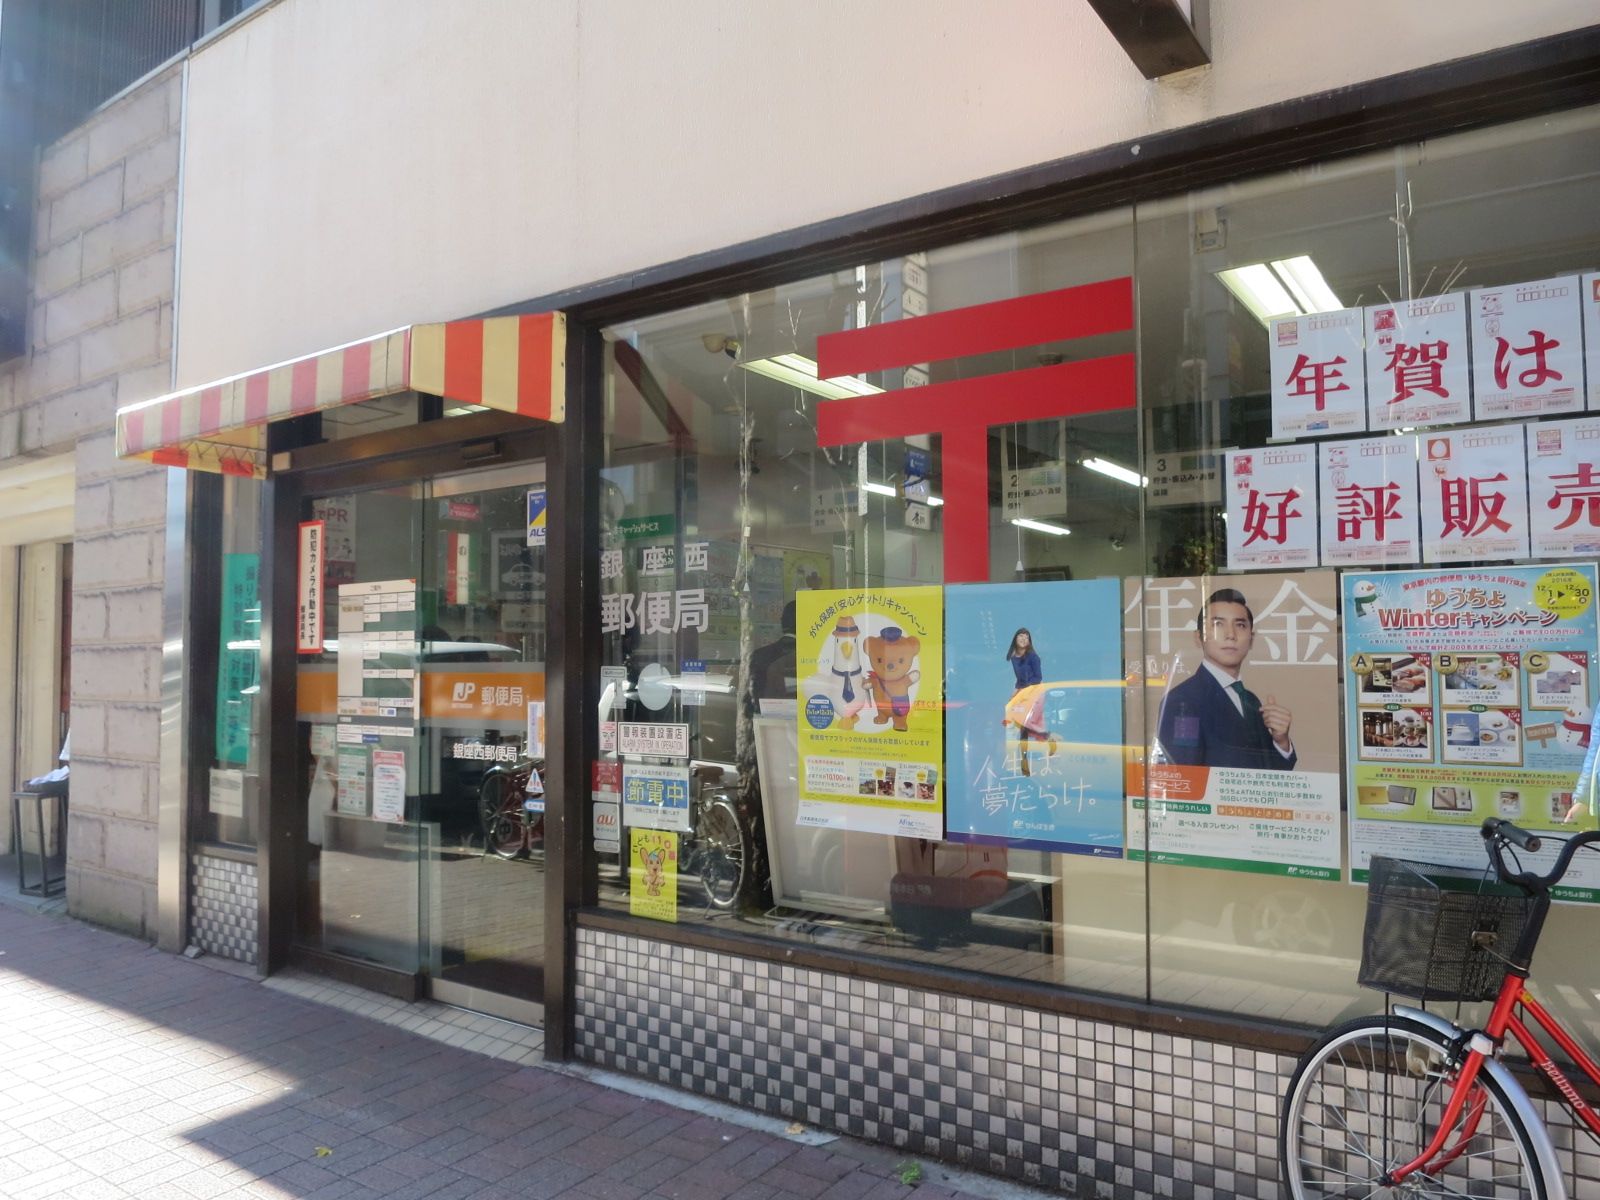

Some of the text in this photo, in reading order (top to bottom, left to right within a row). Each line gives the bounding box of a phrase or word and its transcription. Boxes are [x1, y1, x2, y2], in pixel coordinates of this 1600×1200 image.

[1285, 330, 1563, 412] 年賀は
[1157, 459, 1166, 472] 3
[1011, 475, 1019, 487] 2
[1242, 463, 1600, 547] 好評販売
[600, 541, 709, 579] 銀座西
[1426, 587, 1507, 610] ゆうちょ
[601, 588, 709, 635] 郵便局
[1378, 608, 1560, 630] Winterキャンペーン
[1125, 578, 1338, 666] 年金
[1355, 655, 1367, 667] A
[1440, 655, 1451, 667] B
[1529, 655, 1542, 667] C
[481, 686, 523, 706] 郵便局
[623, 726, 683, 740] 警報装置設置店
[453, 743, 517, 762] 銀座西郵便局
[622, 739, 636, 747] ALARM
[637, 739, 654, 749] SYSTEM
[660, 740, 684, 750] OPERATION
[973, 751, 1063, 786] 人生は、
[627, 780, 684, 806] 節電中
[979, 777, 1096, 816] 夢だらけ。
[596, 815, 616, 826] au
[1555, 890, 1593, 899] ゆうちょ銀行
